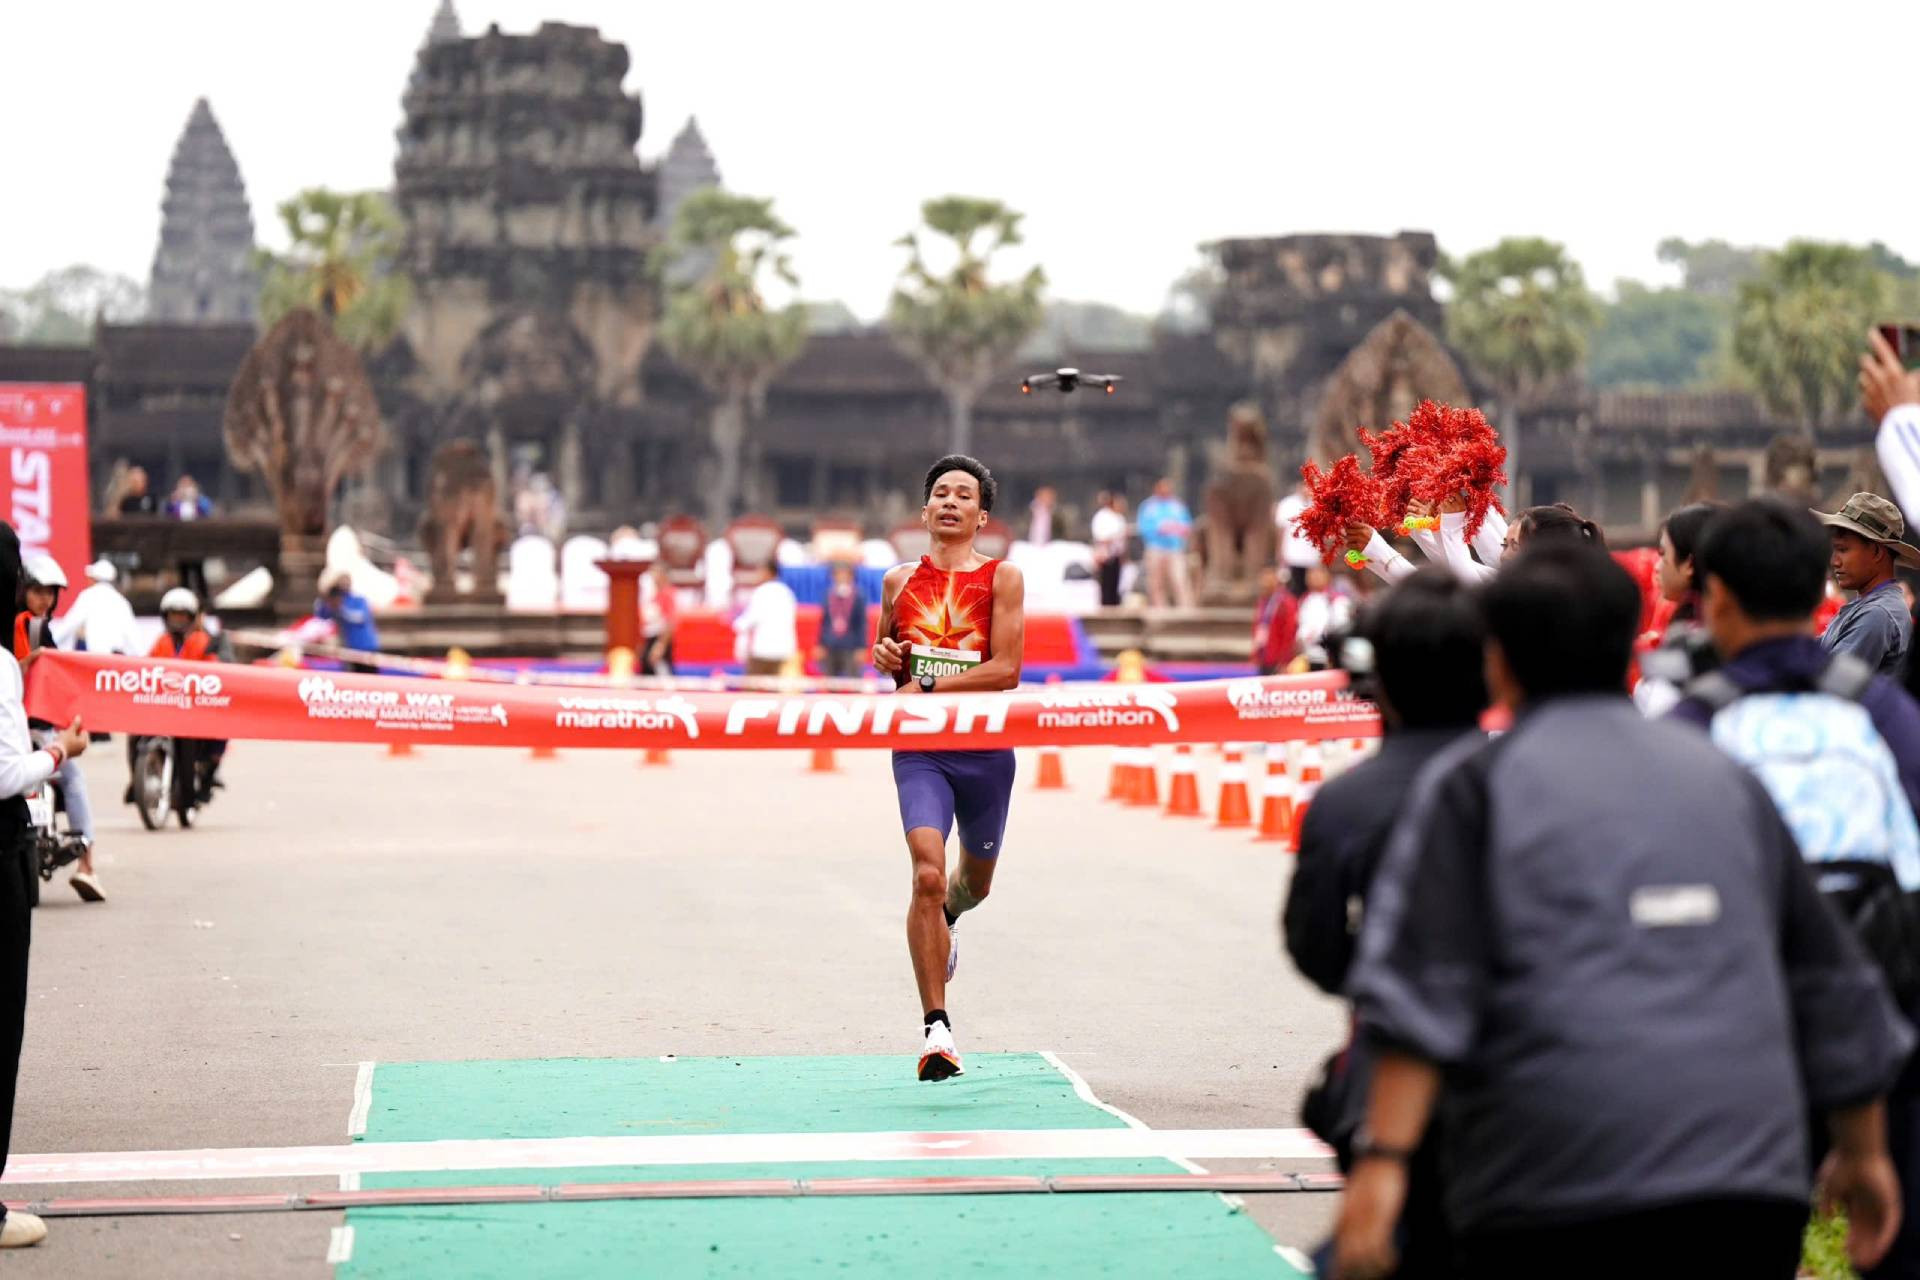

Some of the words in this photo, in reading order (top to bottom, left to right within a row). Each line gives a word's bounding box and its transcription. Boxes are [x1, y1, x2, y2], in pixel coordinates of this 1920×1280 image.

[11, 447, 51, 557] STA
[915, 658, 968, 677] E40001
[95, 666, 222, 695] metfone
[312, 686, 399, 706] ANGKOR
[406, 692, 455, 708] WAT
[1240, 688, 1327, 706] ANGKOR
[379, 707, 454, 722] MARATHON
[556, 710, 674, 728] marathon
[725, 699, 1012, 735] FINISH
[1037, 708, 1155, 727] marathon
